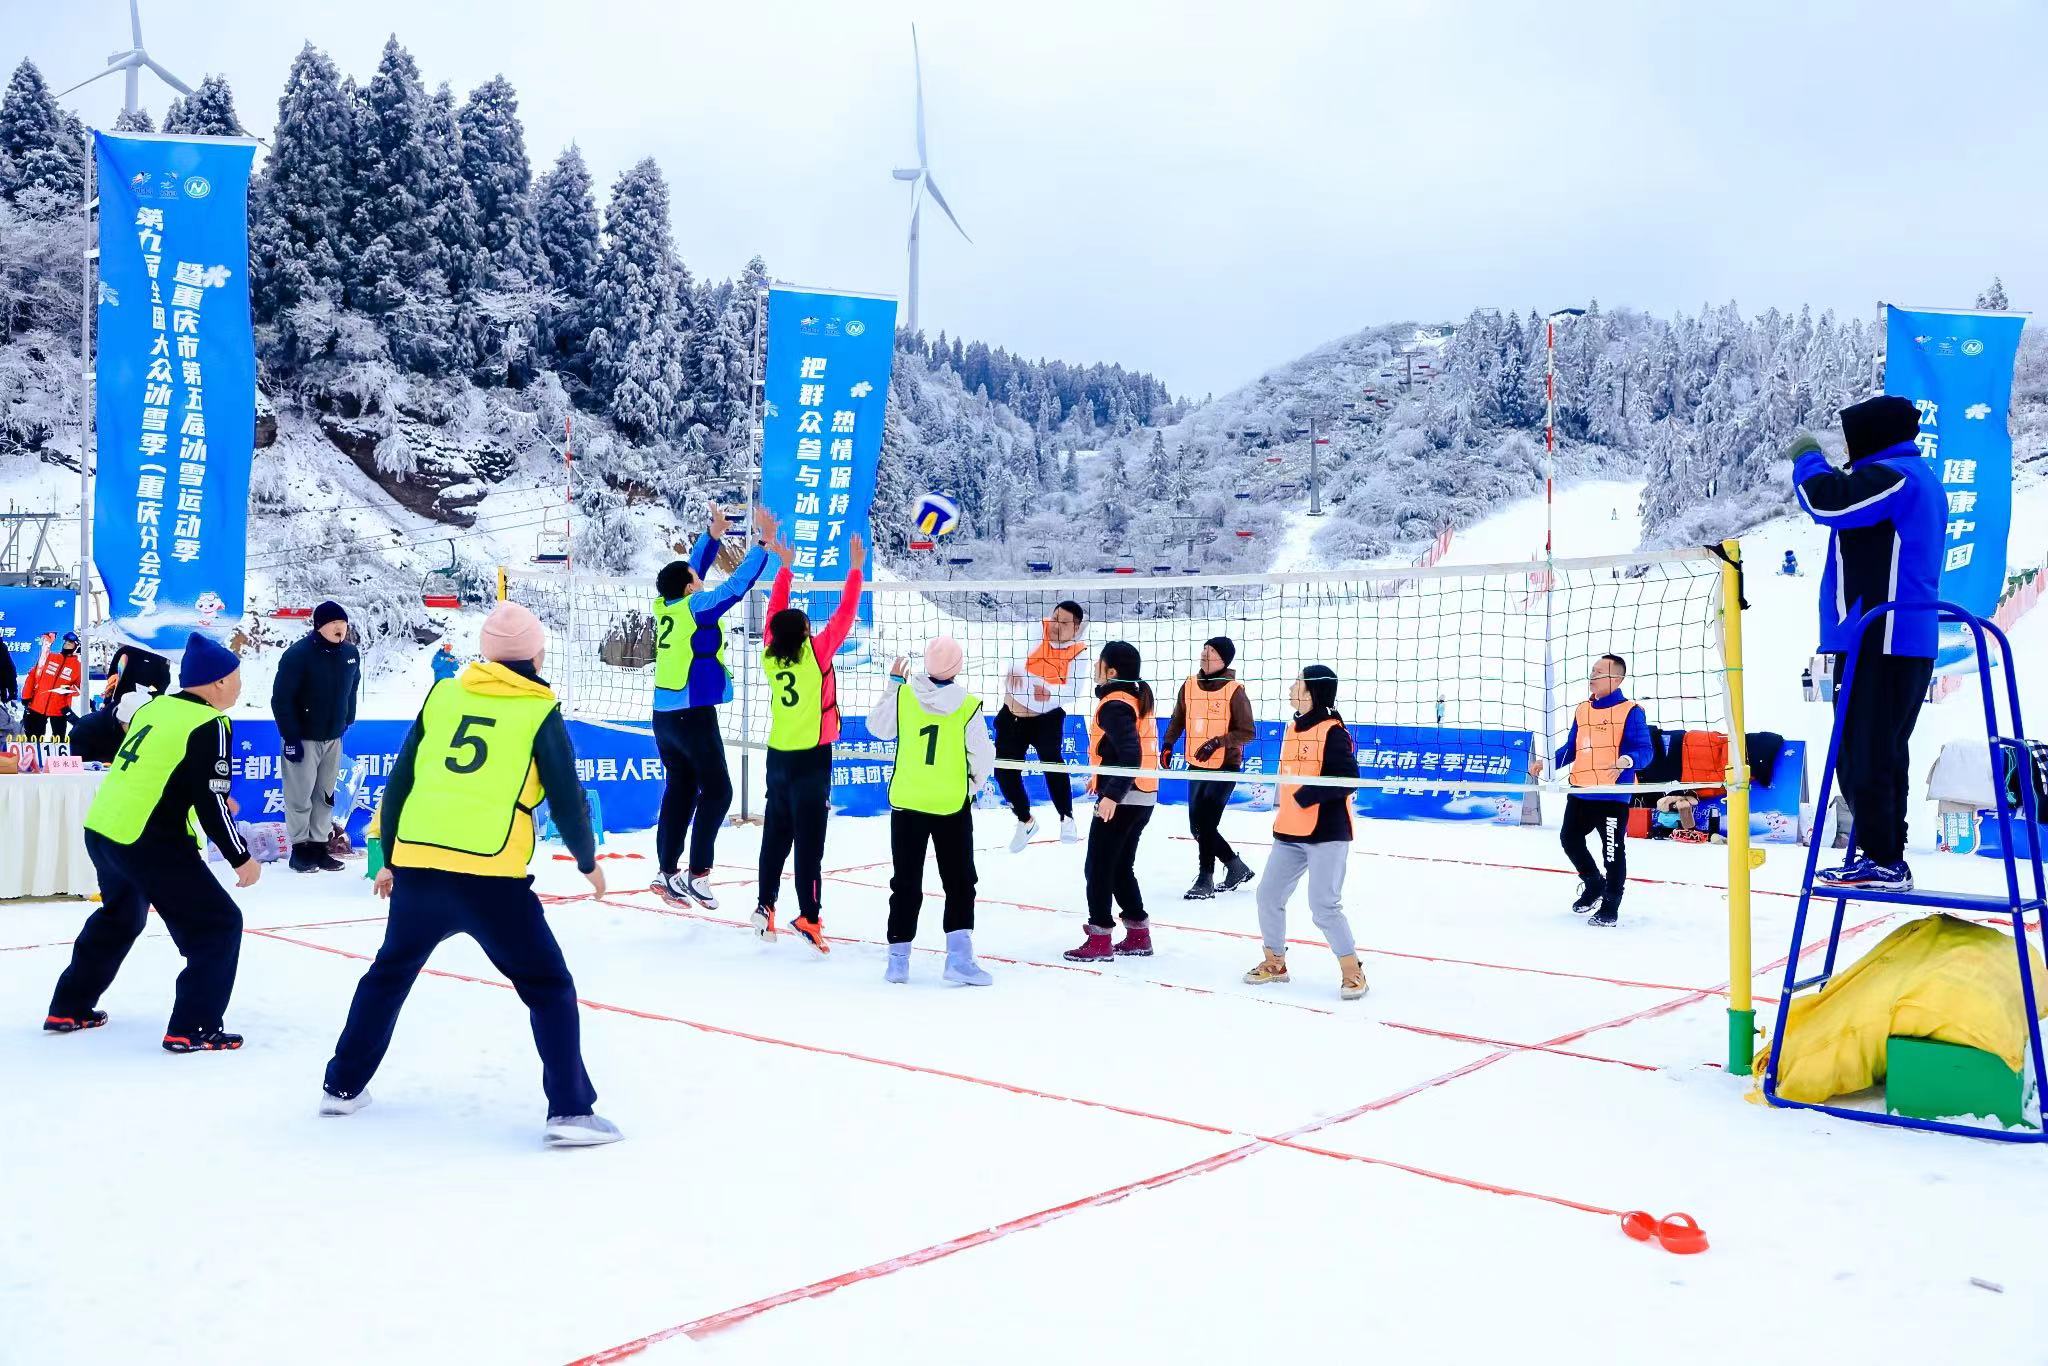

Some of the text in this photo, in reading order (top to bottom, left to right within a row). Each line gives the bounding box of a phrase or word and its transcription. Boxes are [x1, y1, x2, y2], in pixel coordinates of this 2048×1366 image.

[171, 261, 208, 563] 暨重庆市第五届冰雪运动季
[1914, 399, 1939, 476] 欢乐
[820, 409, 855, 567] 热情保持下去
[1942, 458, 1978, 572] 健康中国
[658, 616, 674, 649] 2
[776, 671, 799, 707] 3
[118, 724, 153, 771] 4
[445, 714, 496, 774] 5
[919, 724, 939, 765] 1
[1356, 749, 1512, 775] 重庆市冬季运动
[575, 758, 666, 781] 都县人民
[1606, 816, 1618, 863] Warriors
